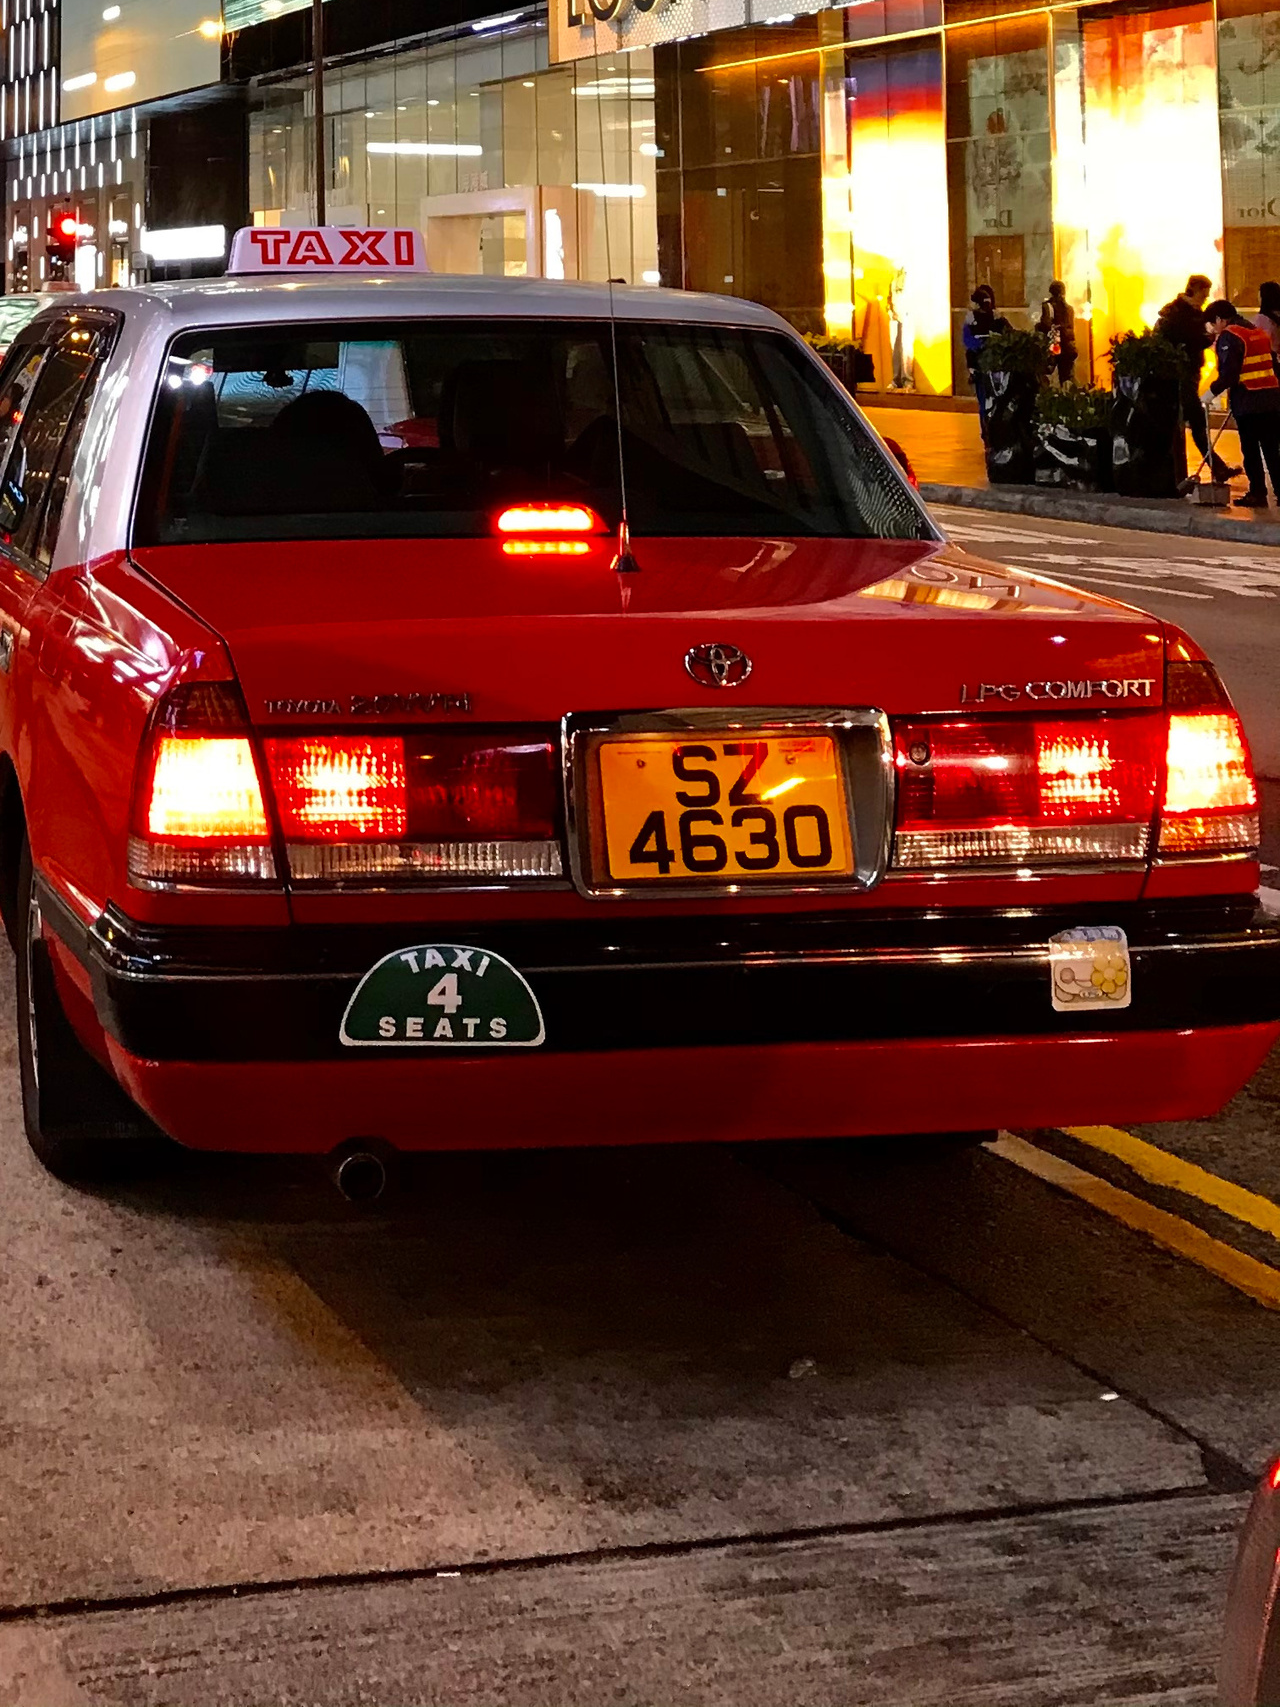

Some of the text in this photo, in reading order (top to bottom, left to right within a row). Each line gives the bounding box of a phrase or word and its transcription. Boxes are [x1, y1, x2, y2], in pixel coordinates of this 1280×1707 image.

[250, 231, 415, 265] TAXI
[961, 679, 1156, 703] LPG COMFORT
[672, 742, 774, 808] SZ
[629, 804, 832, 874] 4630
[399, 948, 490, 977] TAXI
[427, 973, 462, 1013] 4
[378, 1016, 507, 1038] SEATS
